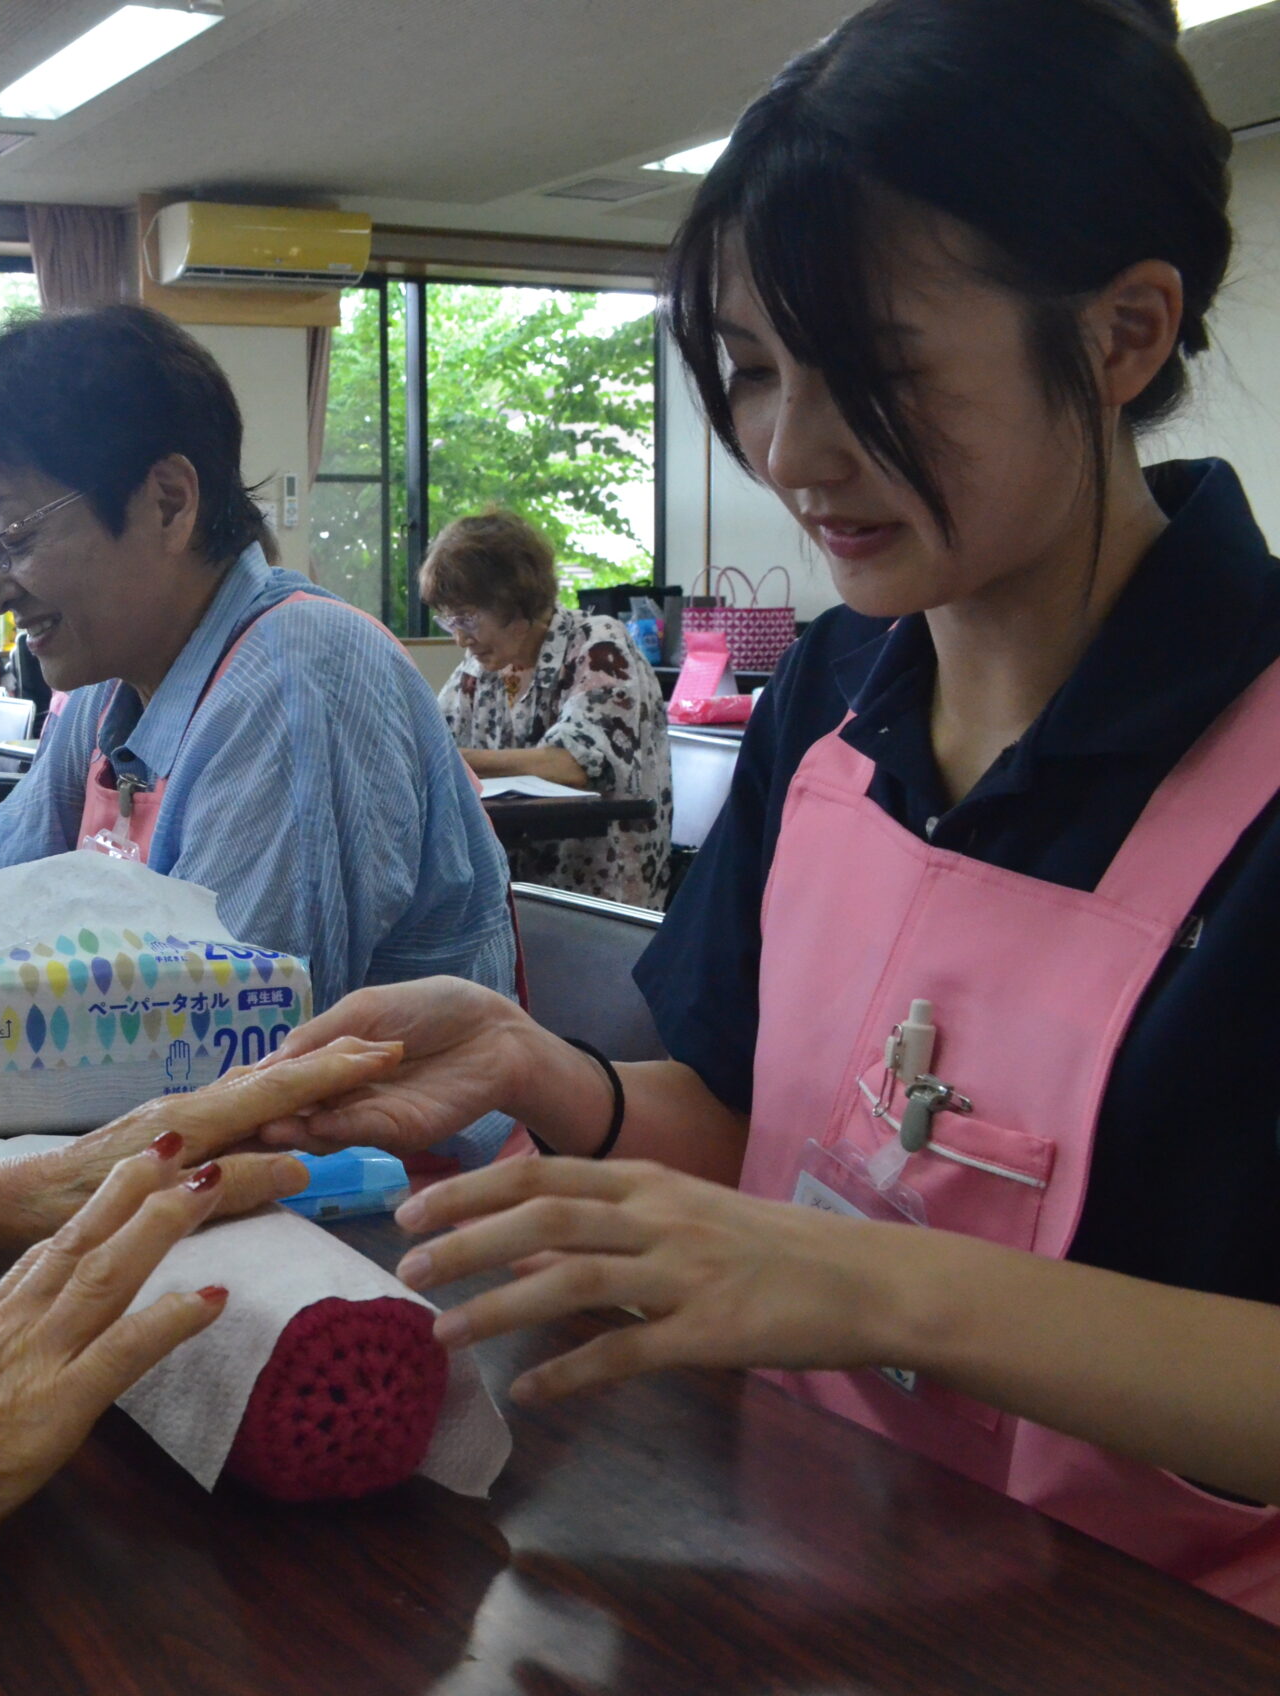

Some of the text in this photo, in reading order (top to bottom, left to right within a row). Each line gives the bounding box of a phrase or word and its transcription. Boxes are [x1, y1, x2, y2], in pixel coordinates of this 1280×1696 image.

[88, 991, 230, 1016] ペーパータオル
[246, 989, 285, 1005] 再生紙
